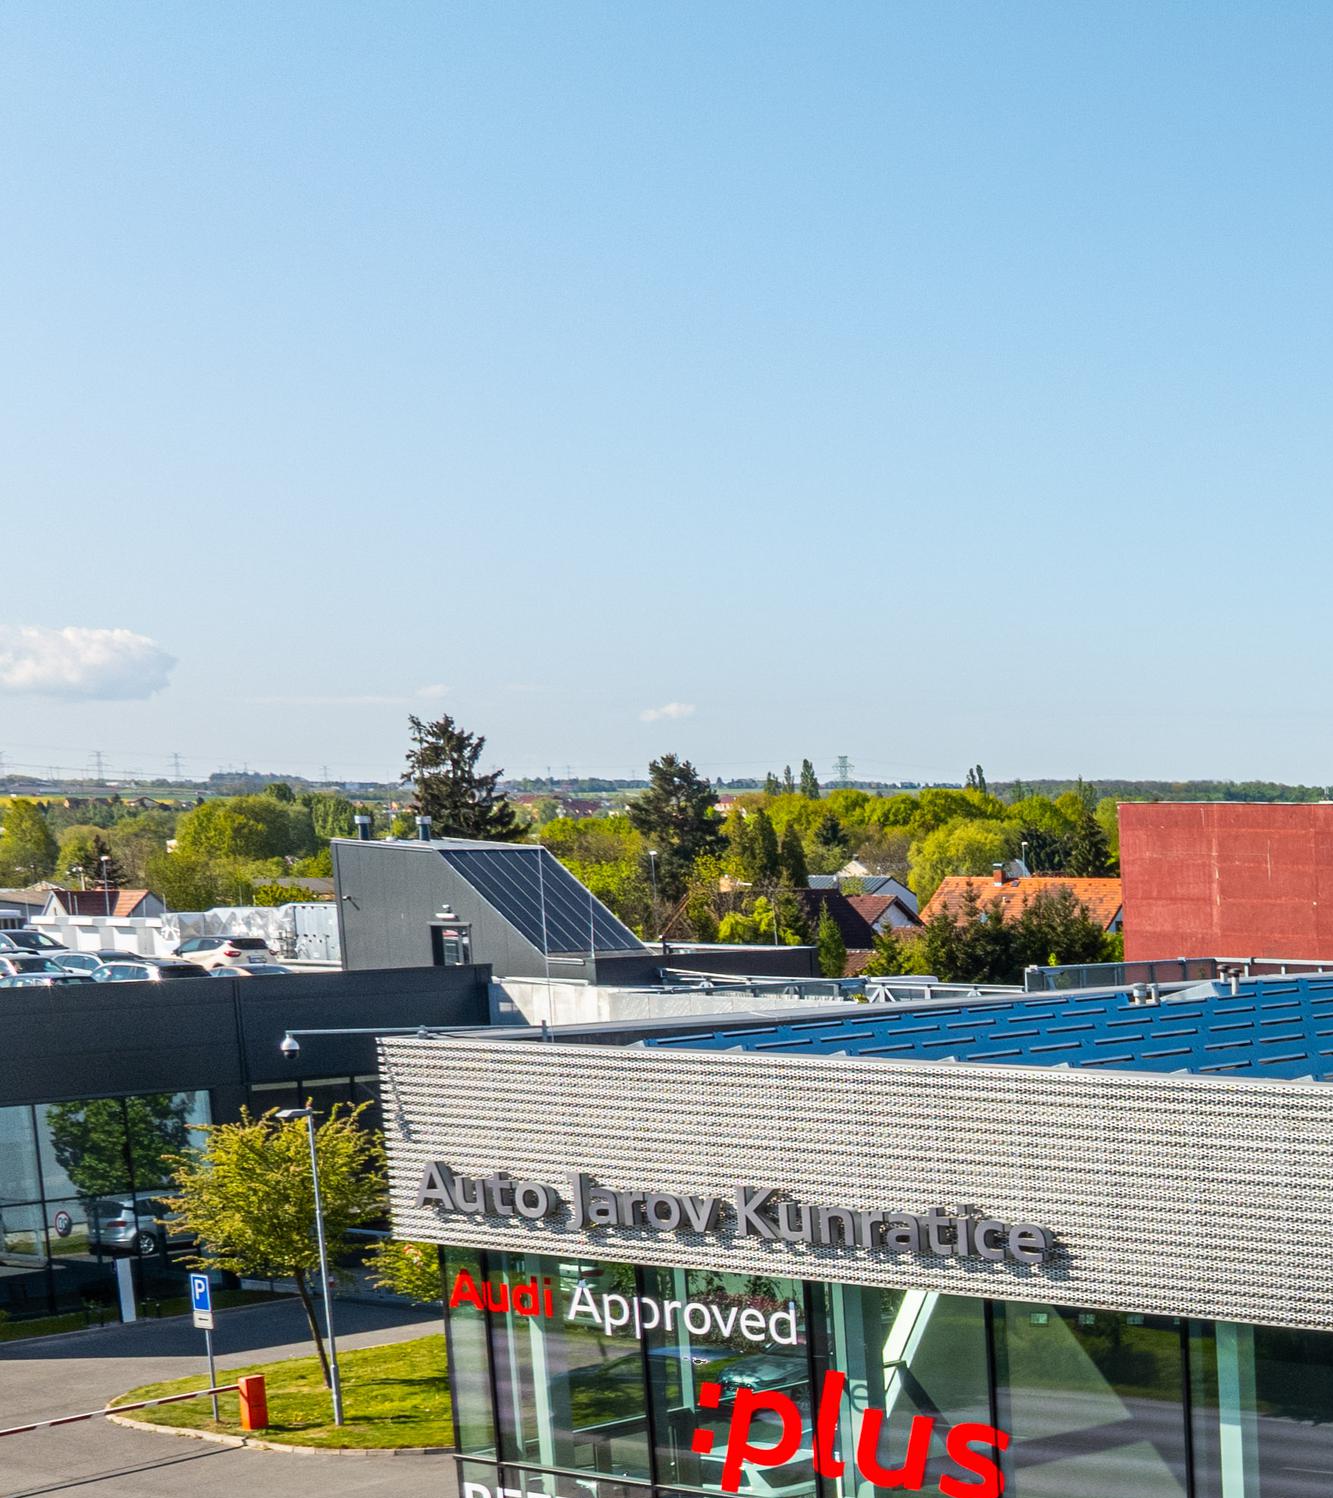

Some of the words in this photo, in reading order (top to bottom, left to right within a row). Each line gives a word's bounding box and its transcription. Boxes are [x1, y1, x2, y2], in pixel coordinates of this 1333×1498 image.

[415, 1161, 559, 1221] Auto
[566, 1173, 727, 1234] Jarov
[734, 1184, 1056, 1264] Kunratice
[194, 1278, 205, 1300] P
[449, 1269, 554, 1319] Audi
[567, 1281, 799, 1346] Approved
